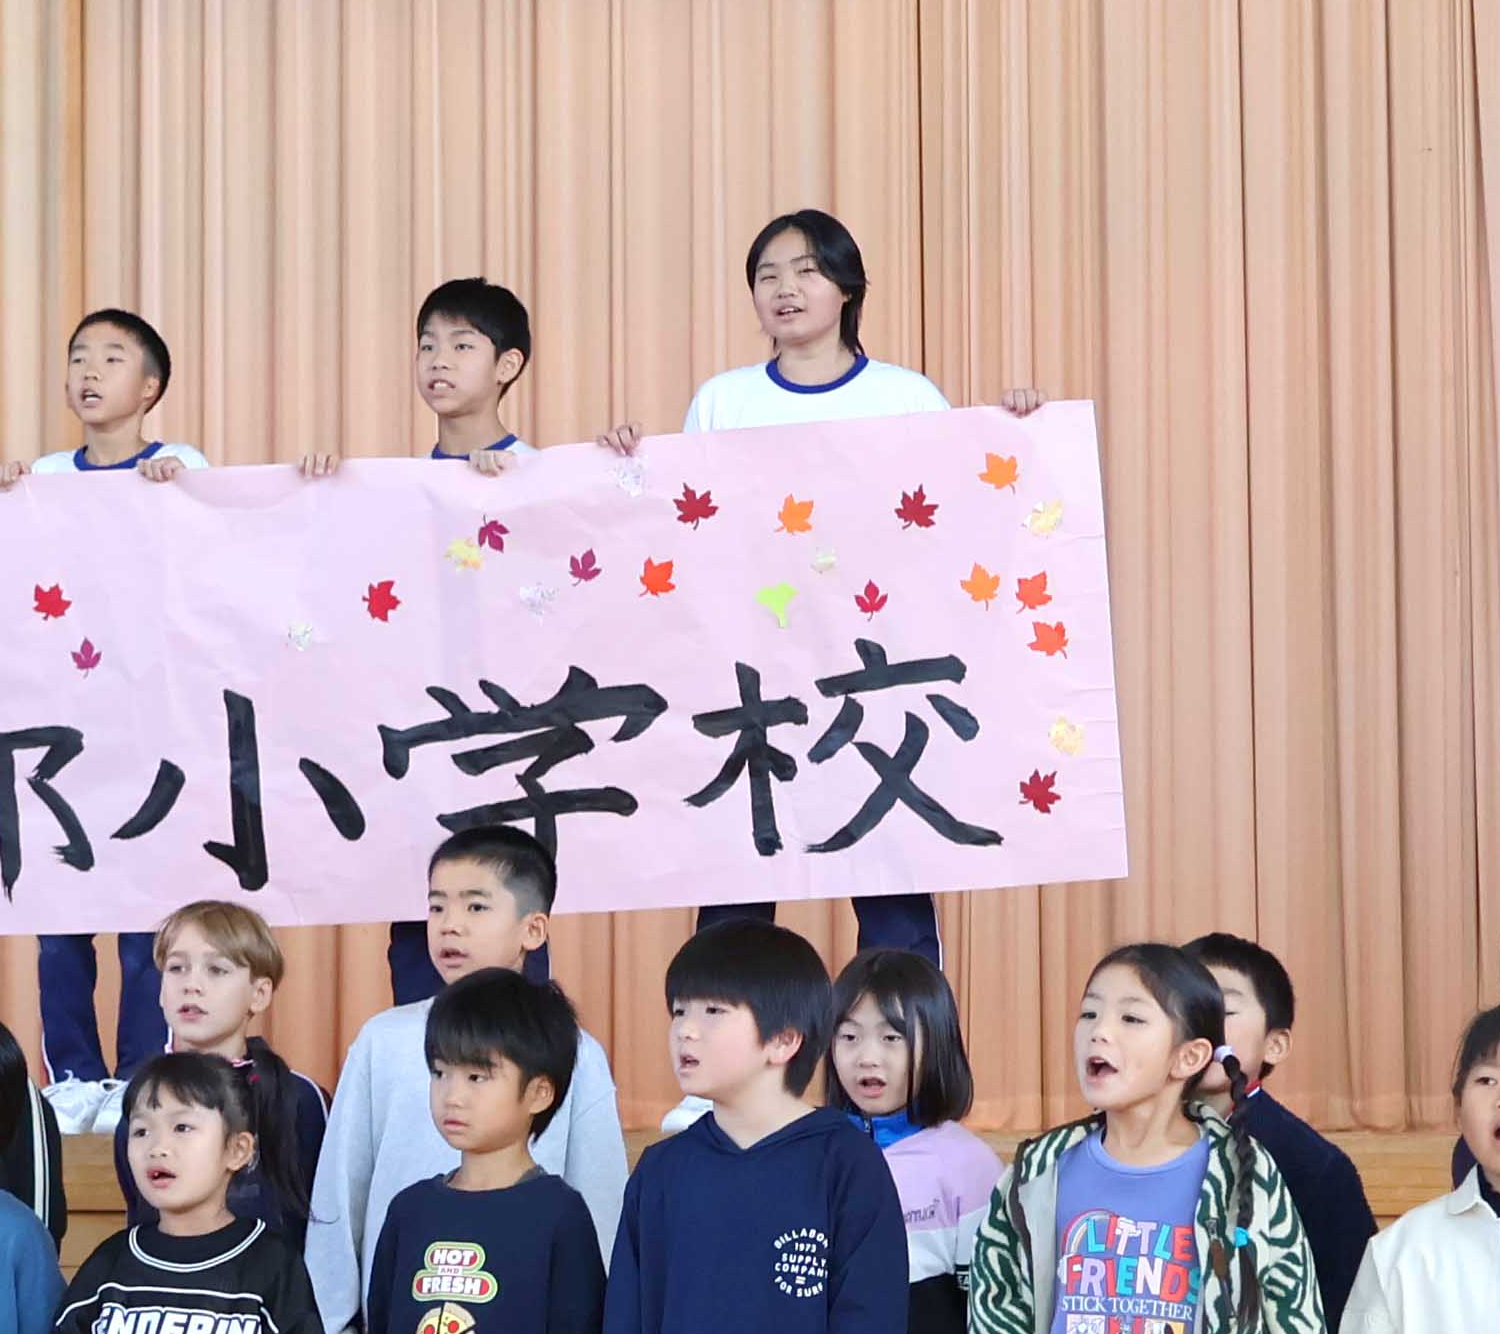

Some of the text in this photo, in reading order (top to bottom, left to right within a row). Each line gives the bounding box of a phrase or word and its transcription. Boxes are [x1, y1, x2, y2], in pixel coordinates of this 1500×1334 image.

[795, 1242, 817, 1253] 1973
[1087, 1215, 1193, 1261] LITTLE
[433, 1249, 475, 1266] HOT
[782, 1252, 827, 1268] SUPPLY
[422, 1276, 482, 1296] FRESH
[774, 1276, 793, 1295] FOR
[1066, 1255, 1200, 1304] FRIENDS
[1062, 1295, 1192, 1321] STICK TOGETHER
